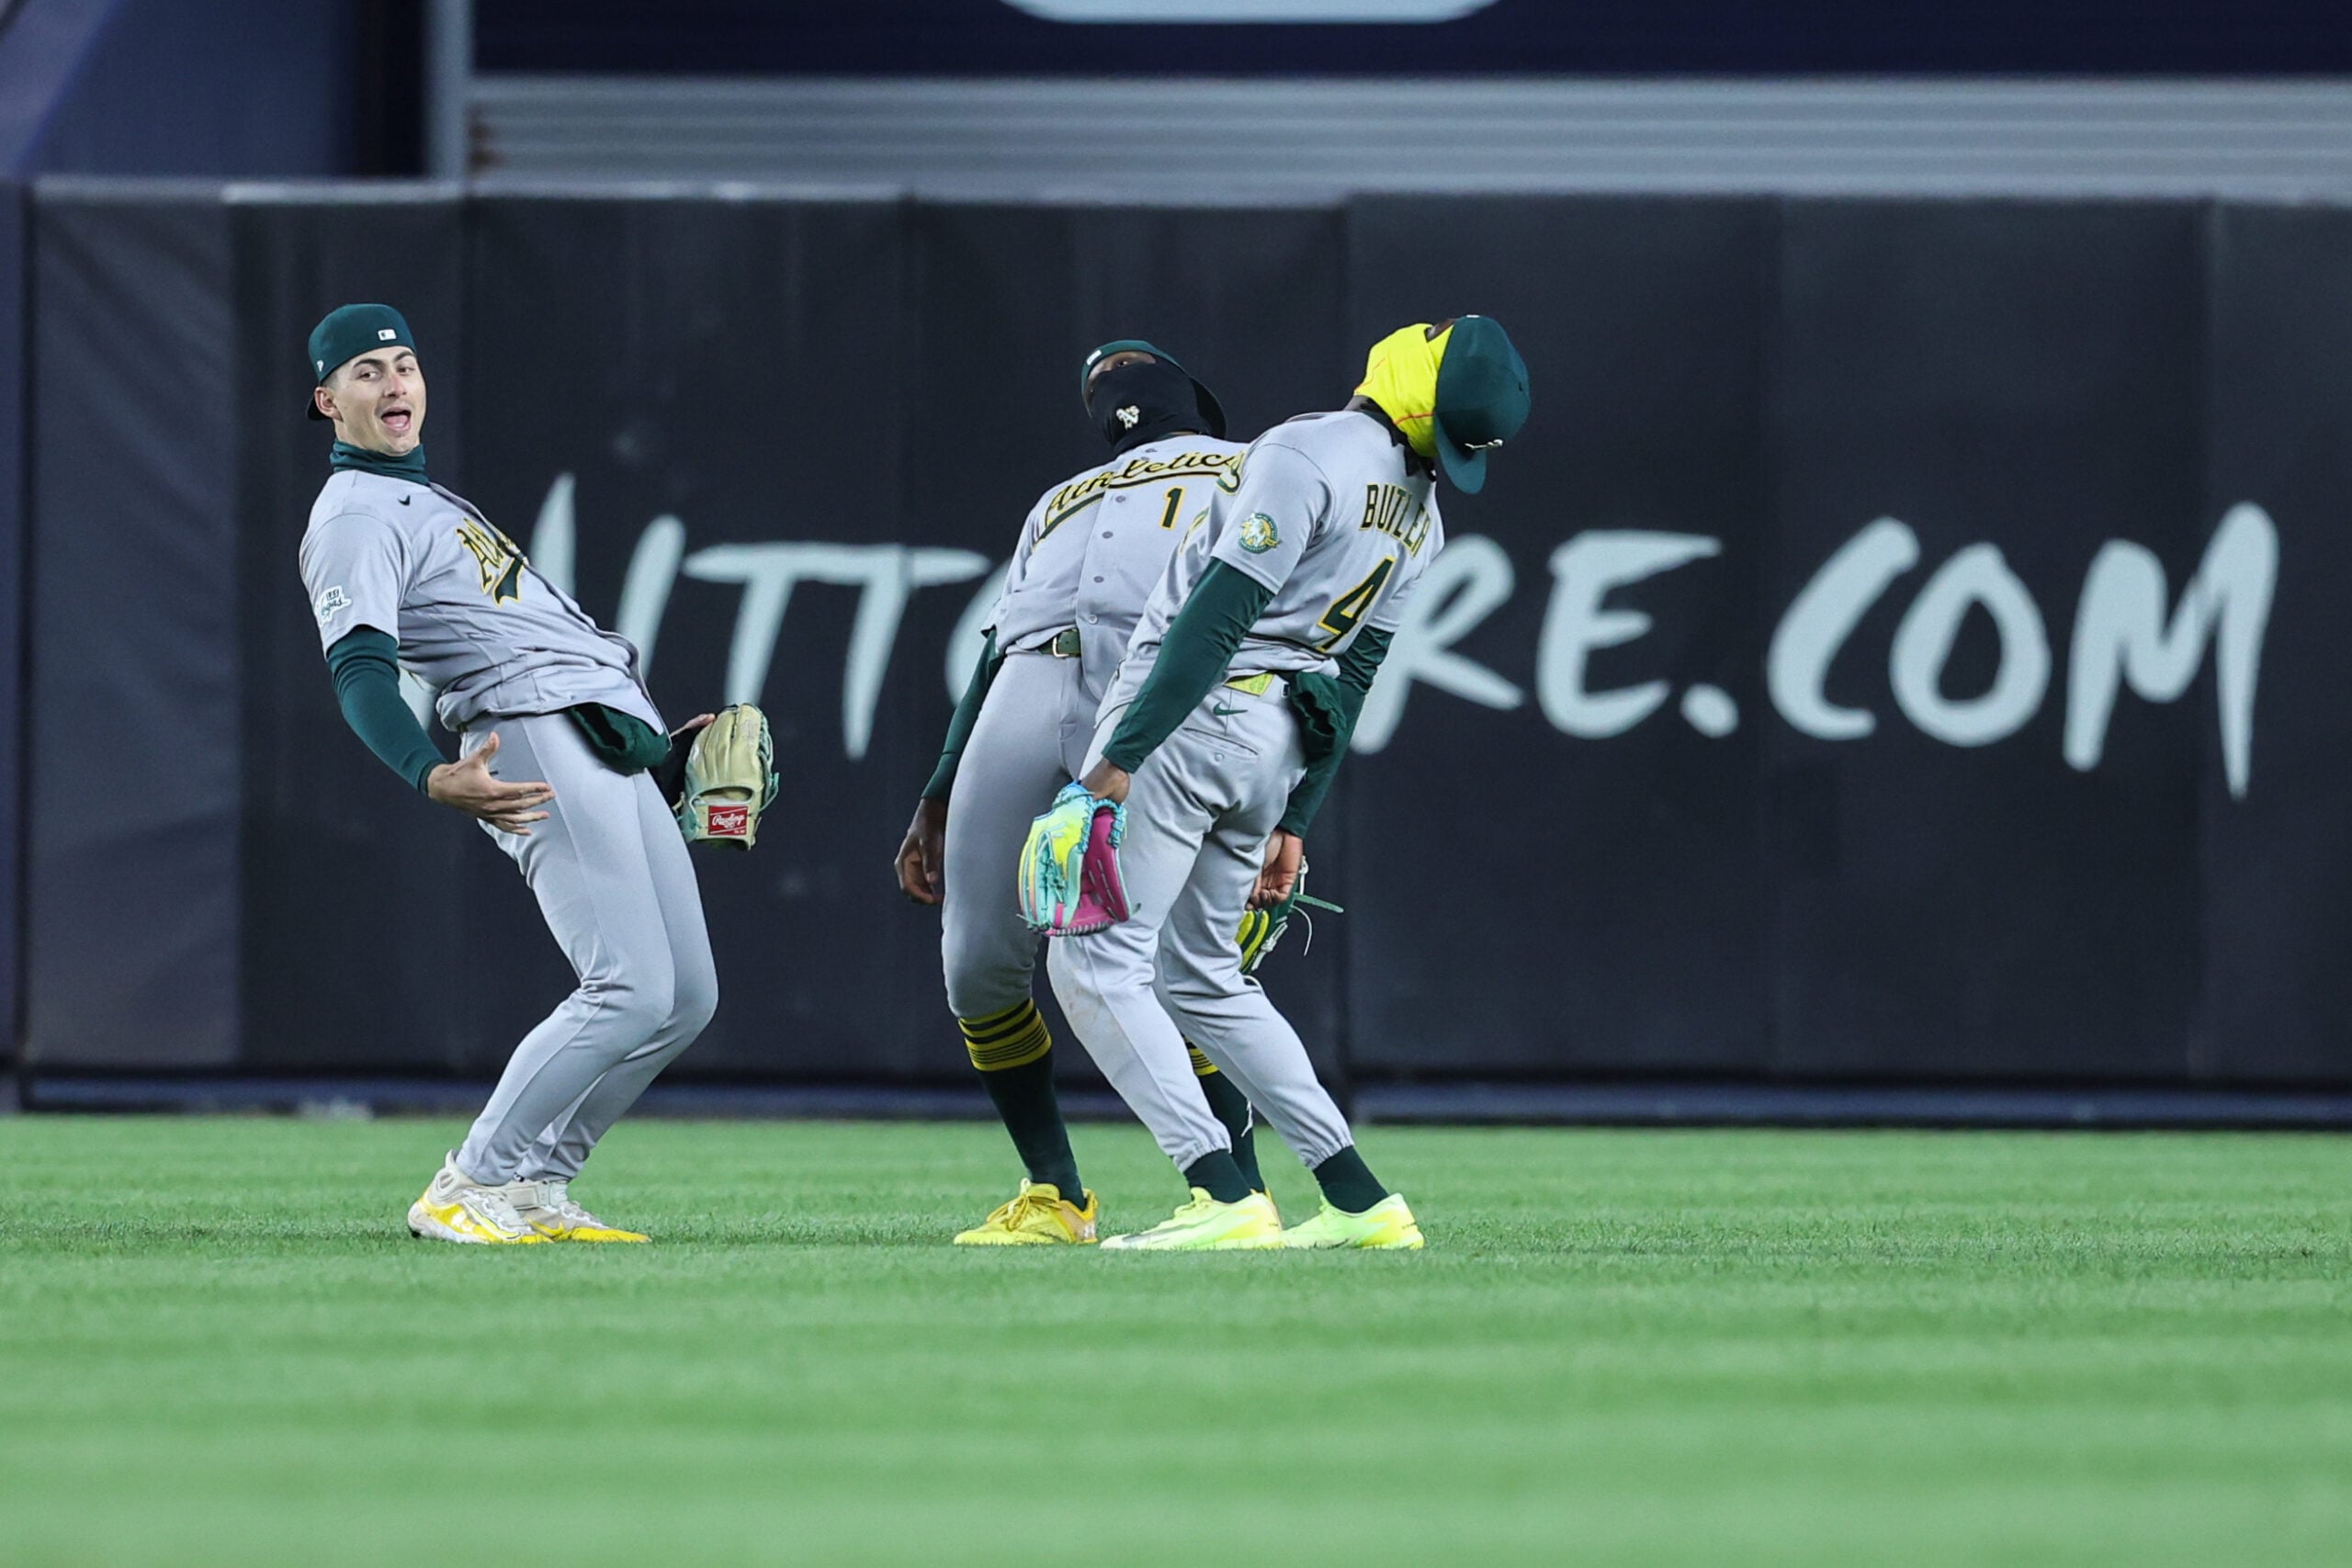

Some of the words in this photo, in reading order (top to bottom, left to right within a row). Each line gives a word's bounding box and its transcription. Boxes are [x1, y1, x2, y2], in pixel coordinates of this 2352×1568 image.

[1159, 486, 1186, 530] 1
[1359, 482, 1430, 558] BUTLER
[1317, 555, 1396, 652] 4
